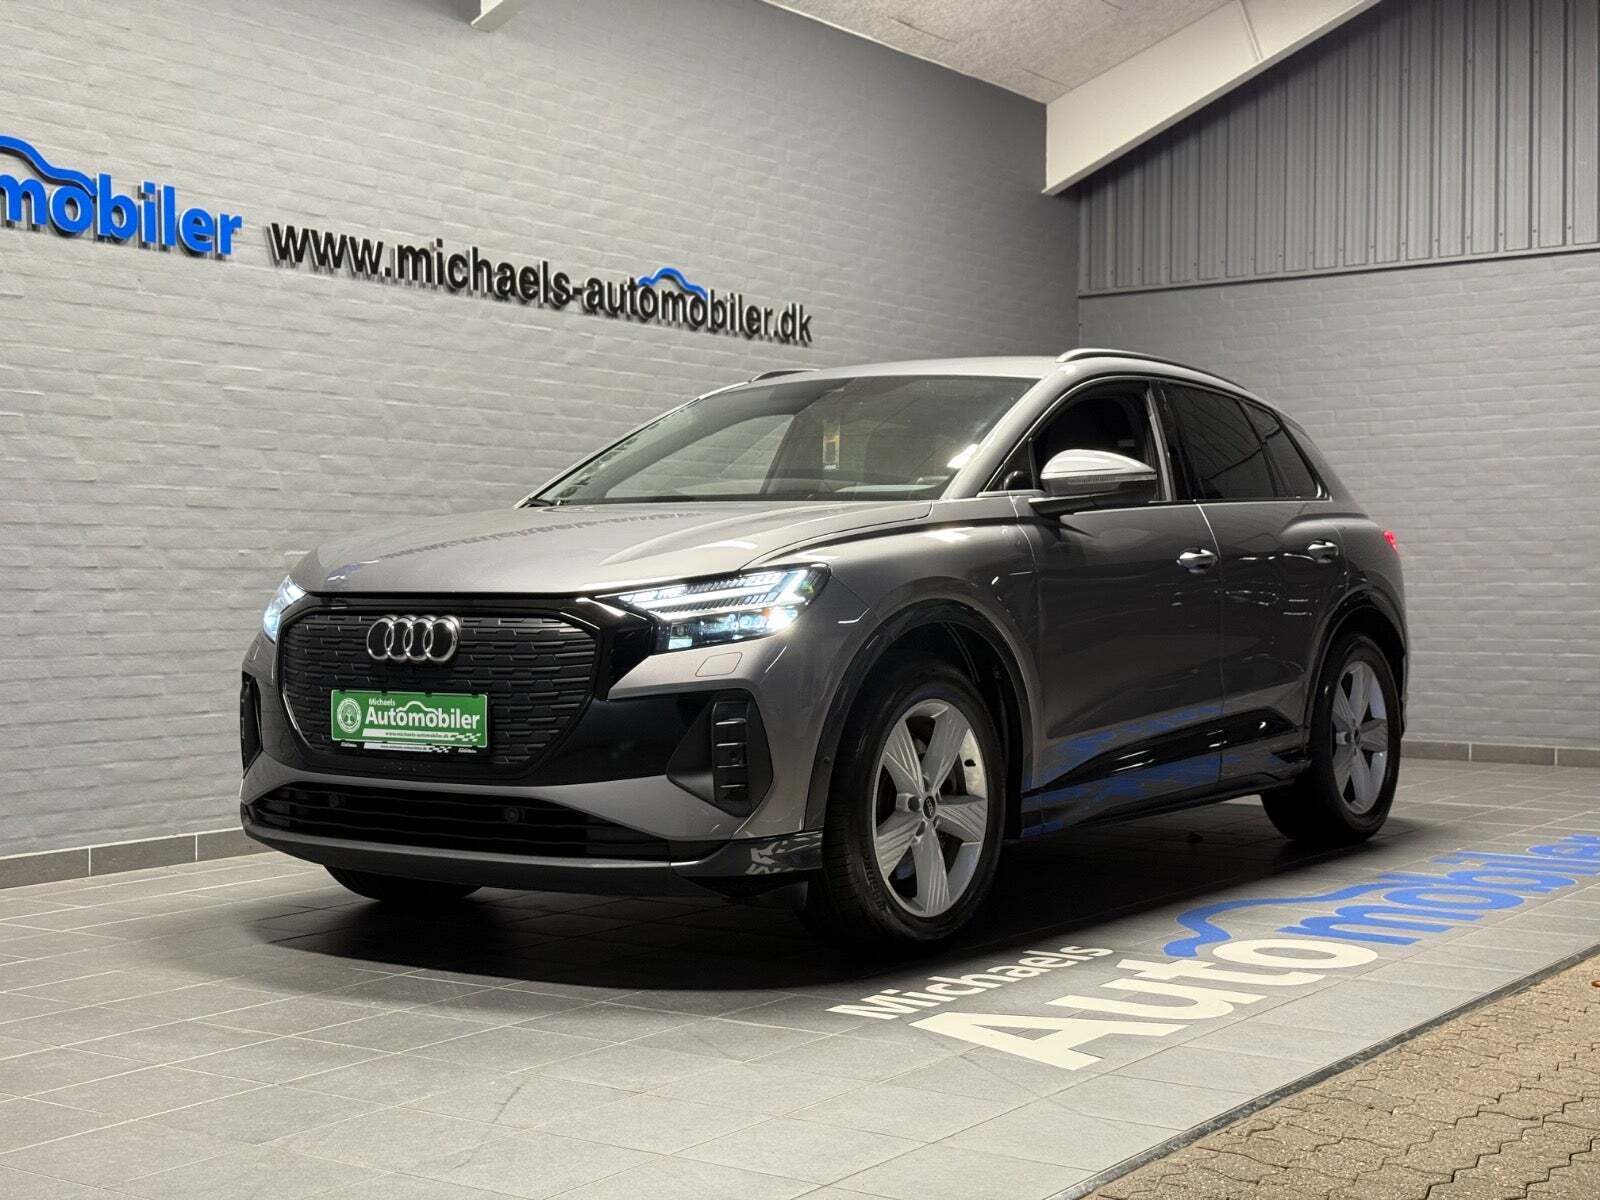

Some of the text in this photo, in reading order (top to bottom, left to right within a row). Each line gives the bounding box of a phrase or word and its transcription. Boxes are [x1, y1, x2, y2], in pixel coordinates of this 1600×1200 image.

[268, 222, 813, 344] www.michaels-automobiler.dk
[365, 706, 481, 729] Automobiler
[368, 698, 396, 707] Michaels
[825, 944, 1114, 1020] Michaels
